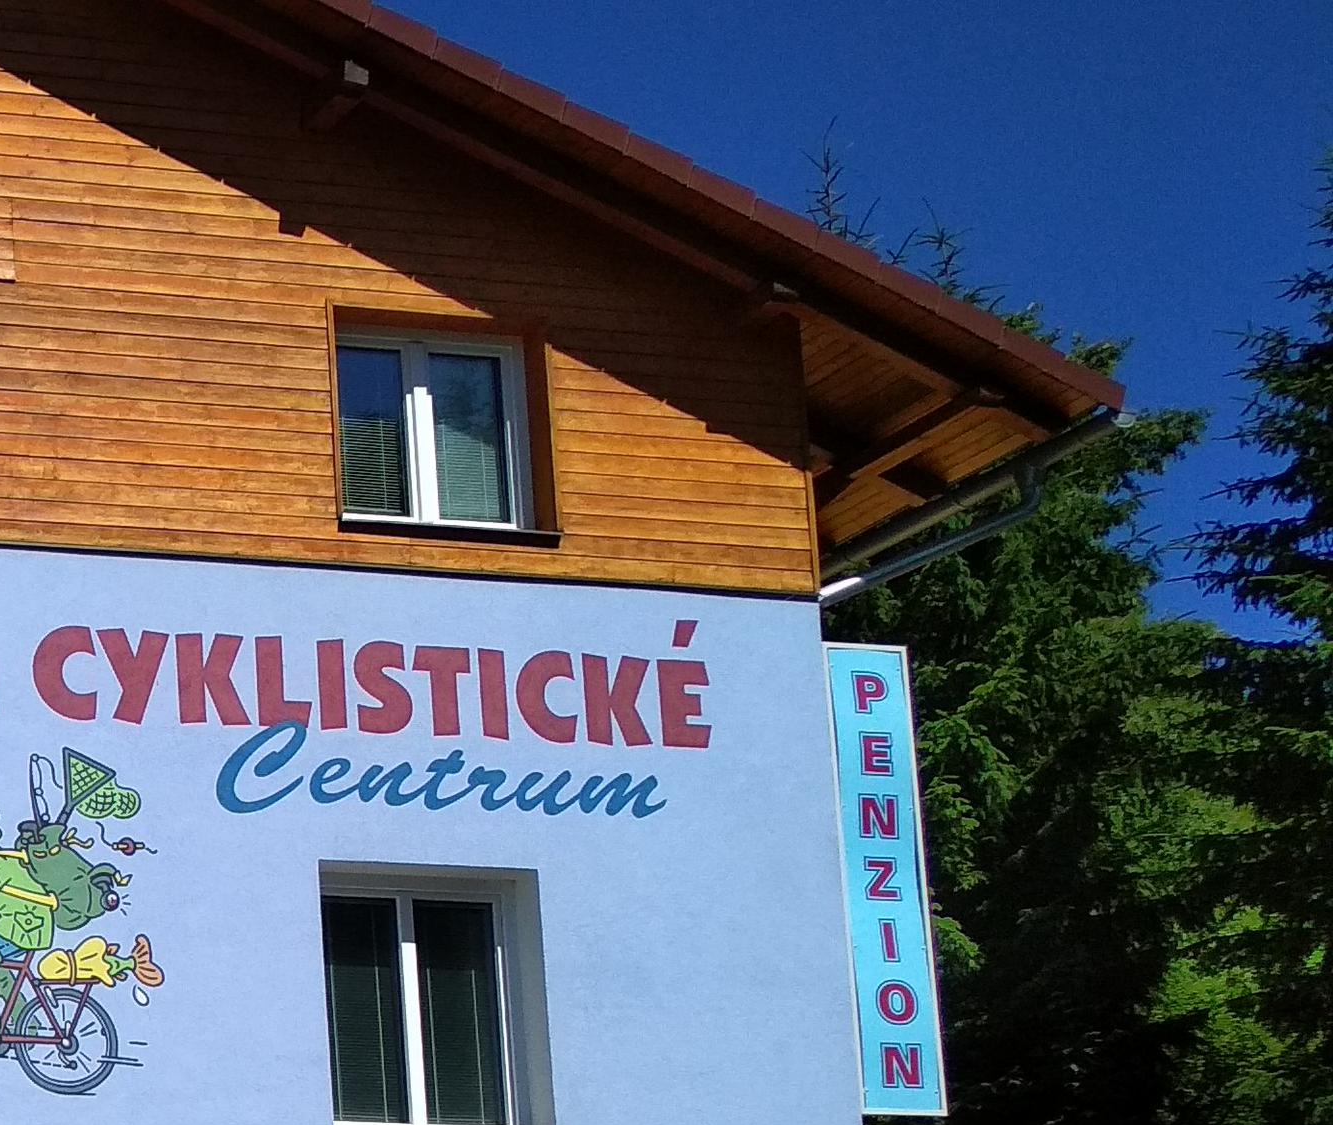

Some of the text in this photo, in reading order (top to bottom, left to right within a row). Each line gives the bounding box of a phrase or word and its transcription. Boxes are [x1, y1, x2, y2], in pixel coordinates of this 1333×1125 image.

[32, 619, 712, 749] CYKLISTICKÉ
[215, 719, 669, 818] Centrum
[849, 670, 924, 1088] PENZION
